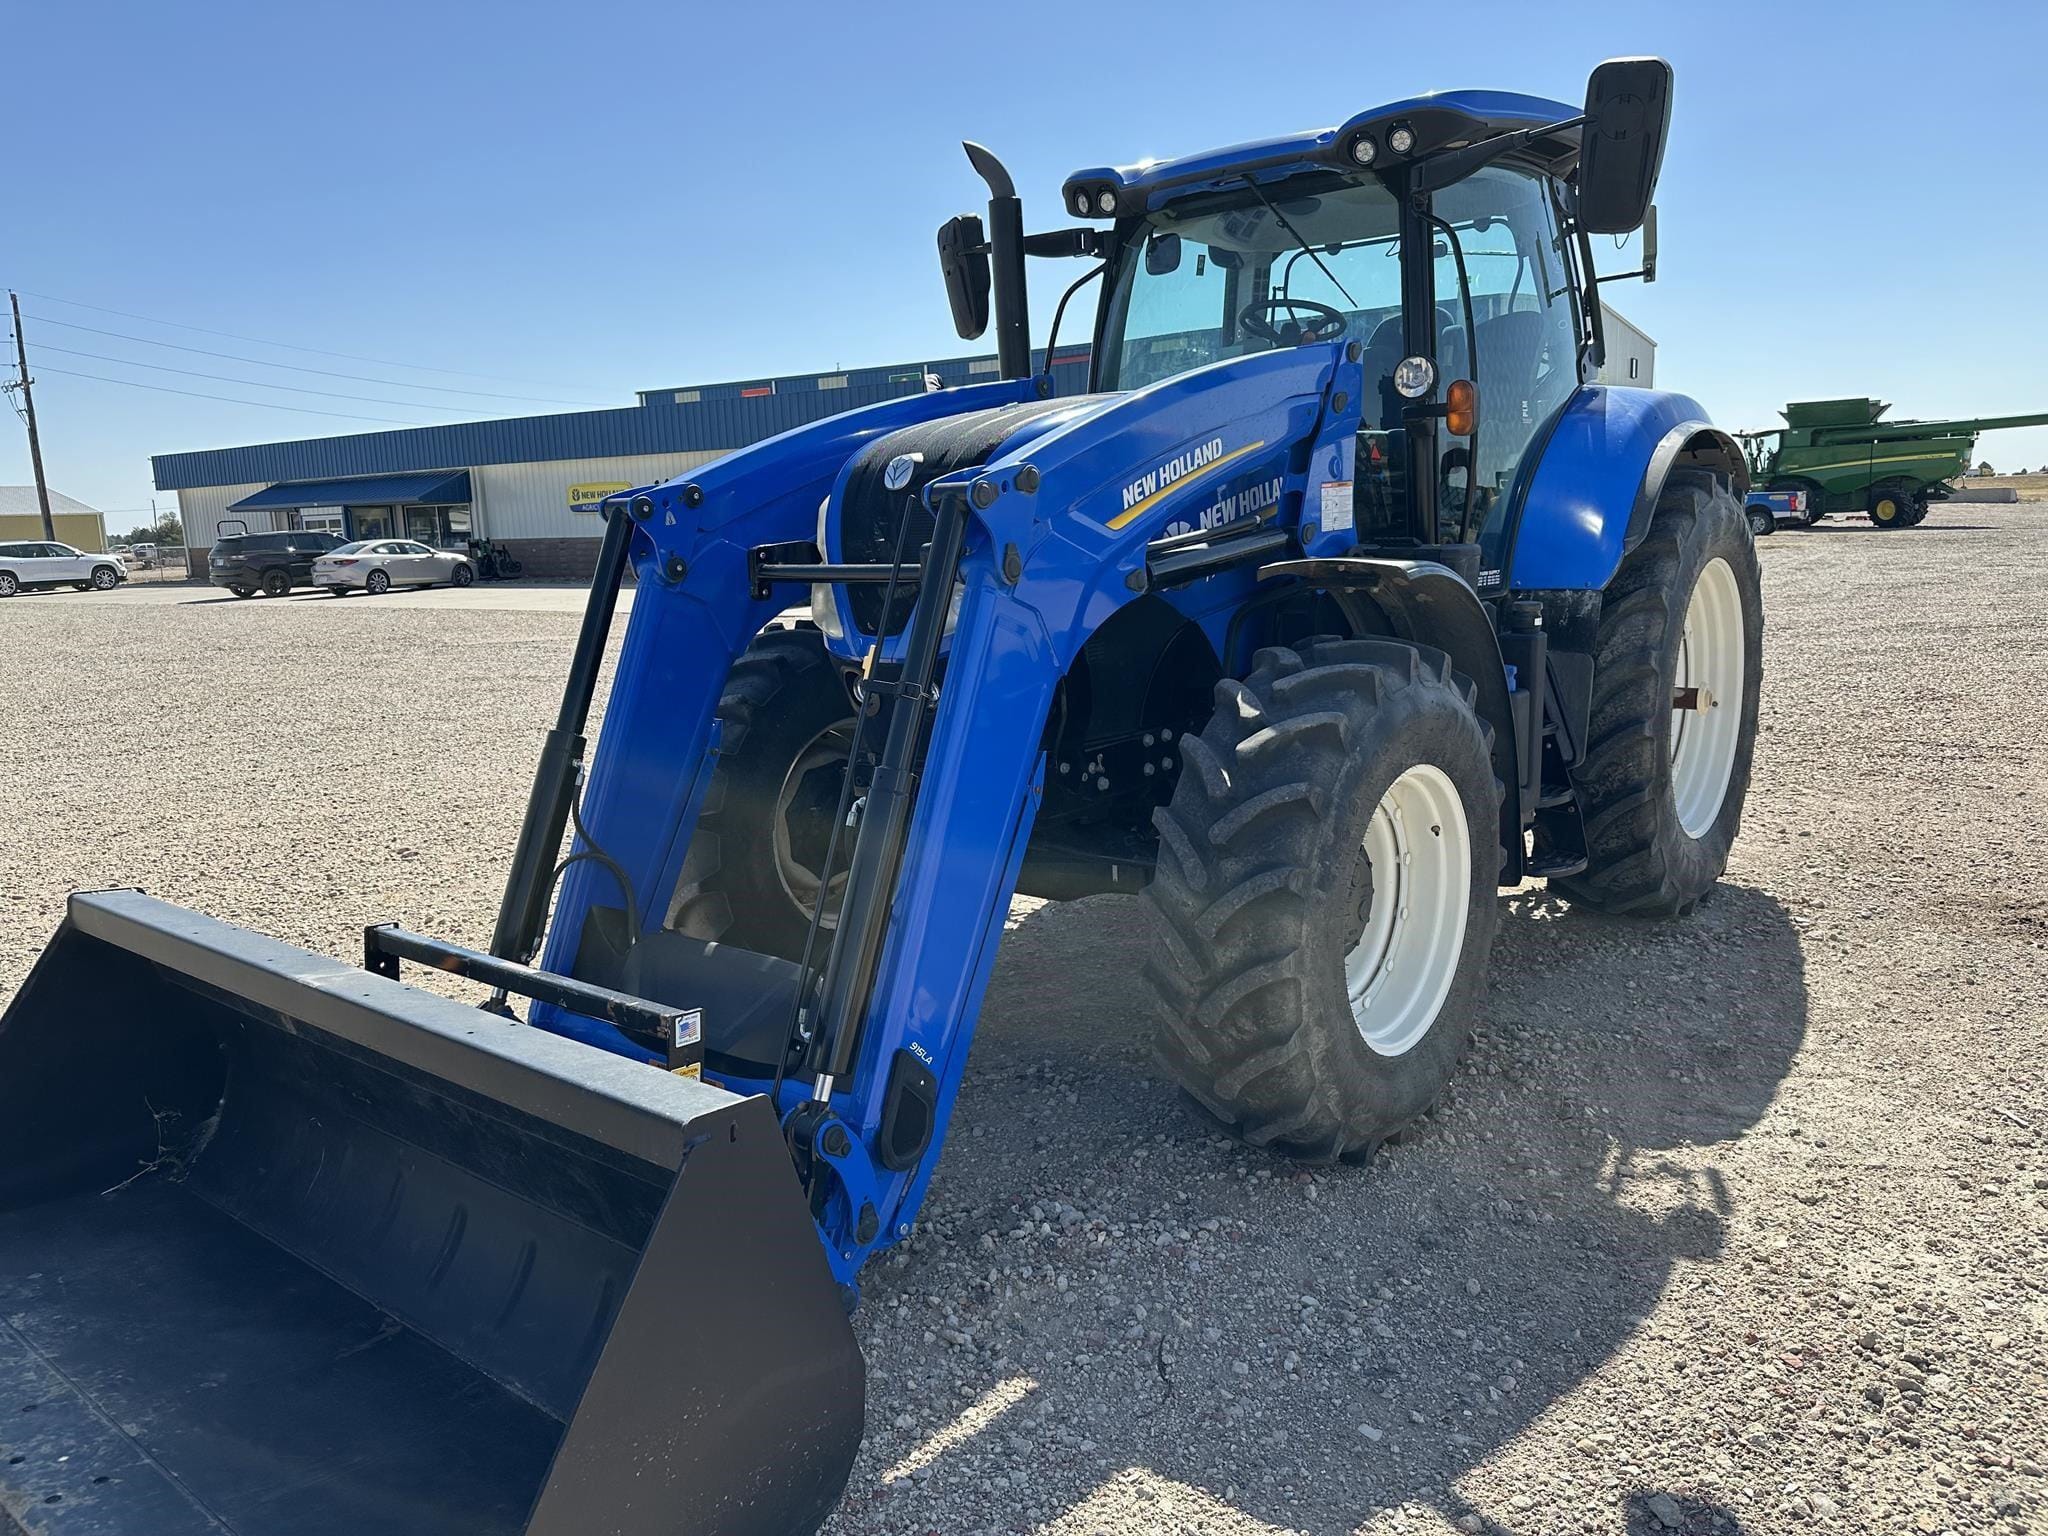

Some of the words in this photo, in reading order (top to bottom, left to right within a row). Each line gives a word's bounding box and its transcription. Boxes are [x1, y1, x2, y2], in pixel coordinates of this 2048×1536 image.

[1122, 470, 1156, 510] NEW
[1158, 437, 1223, 488] HOLLAND
[581, 491, 596, 499] NEW
[1199, 496, 1236, 530] NEW
[1239, 476, 1283, 517] HOLLA
[909, 1041, 933, 1065] 915LA
